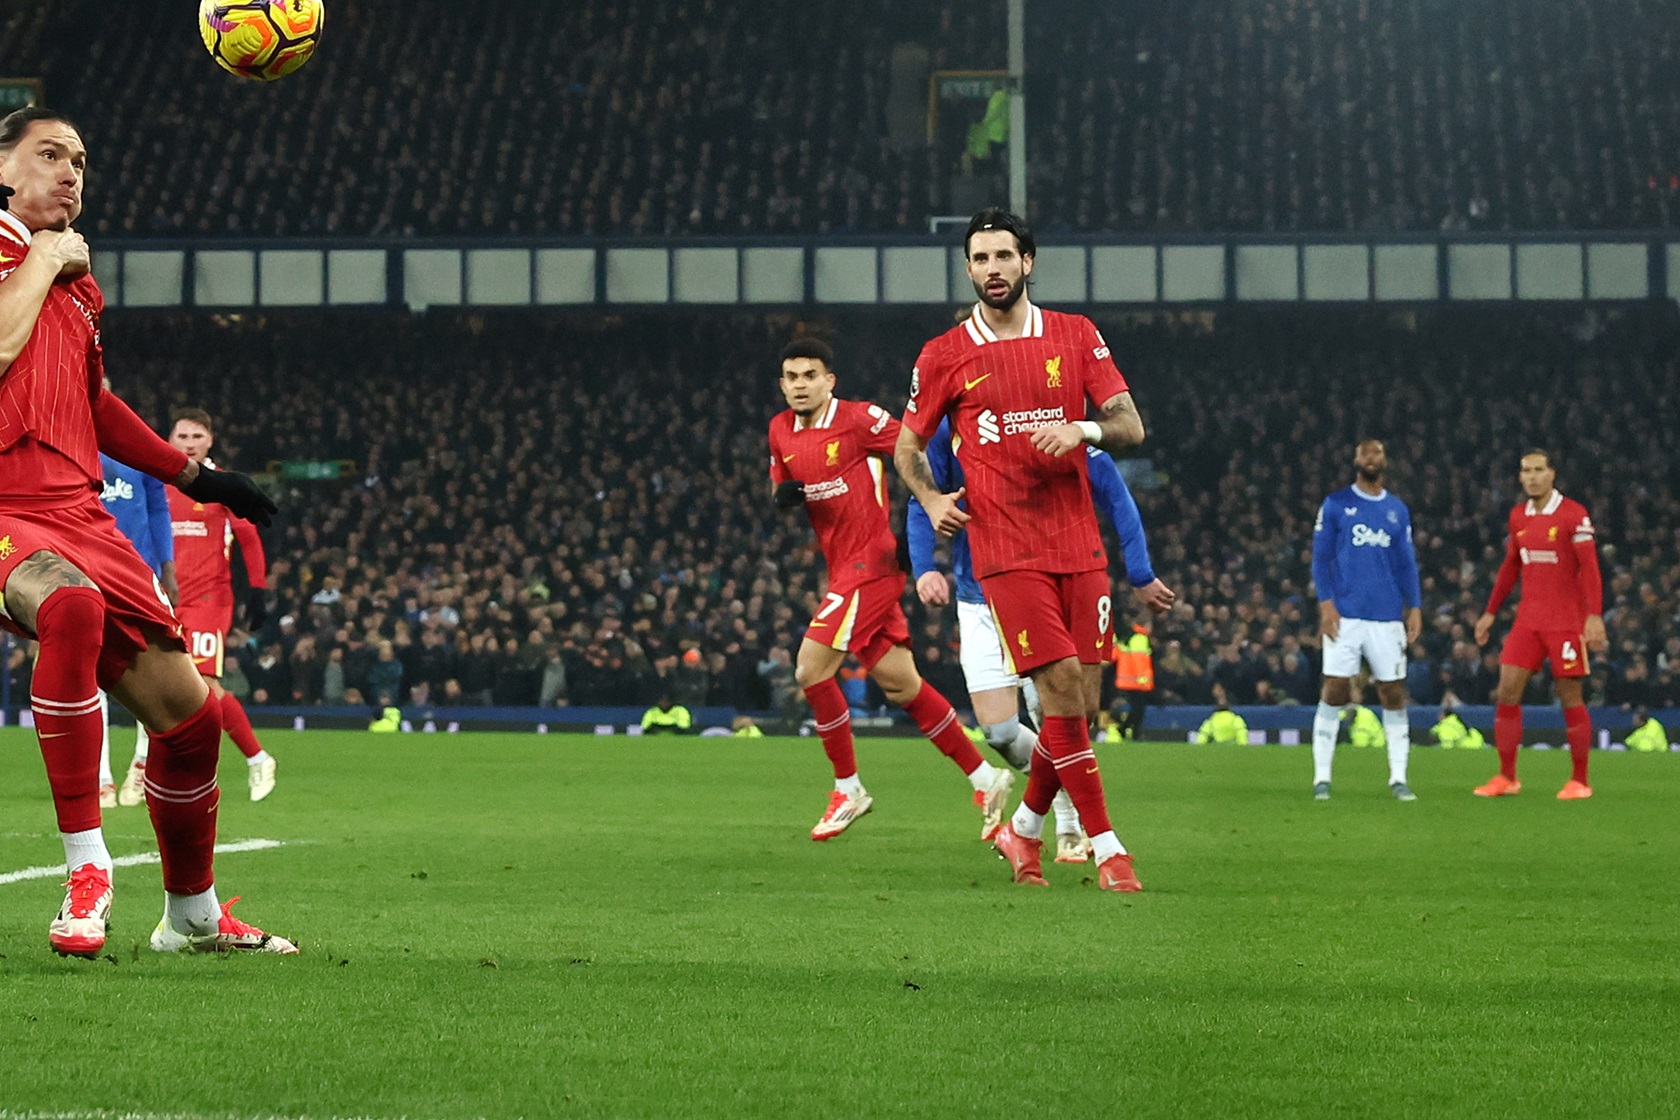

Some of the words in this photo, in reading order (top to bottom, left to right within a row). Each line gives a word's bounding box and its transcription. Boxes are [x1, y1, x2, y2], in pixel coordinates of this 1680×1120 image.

[1002, 405, 1064, 425] standard
[816, 591, 845, 620] 7
[1097, 594, 1112, 635] 8
[191, 631, 217, 658] 10
[1561, 640, 1578, 661] 4
